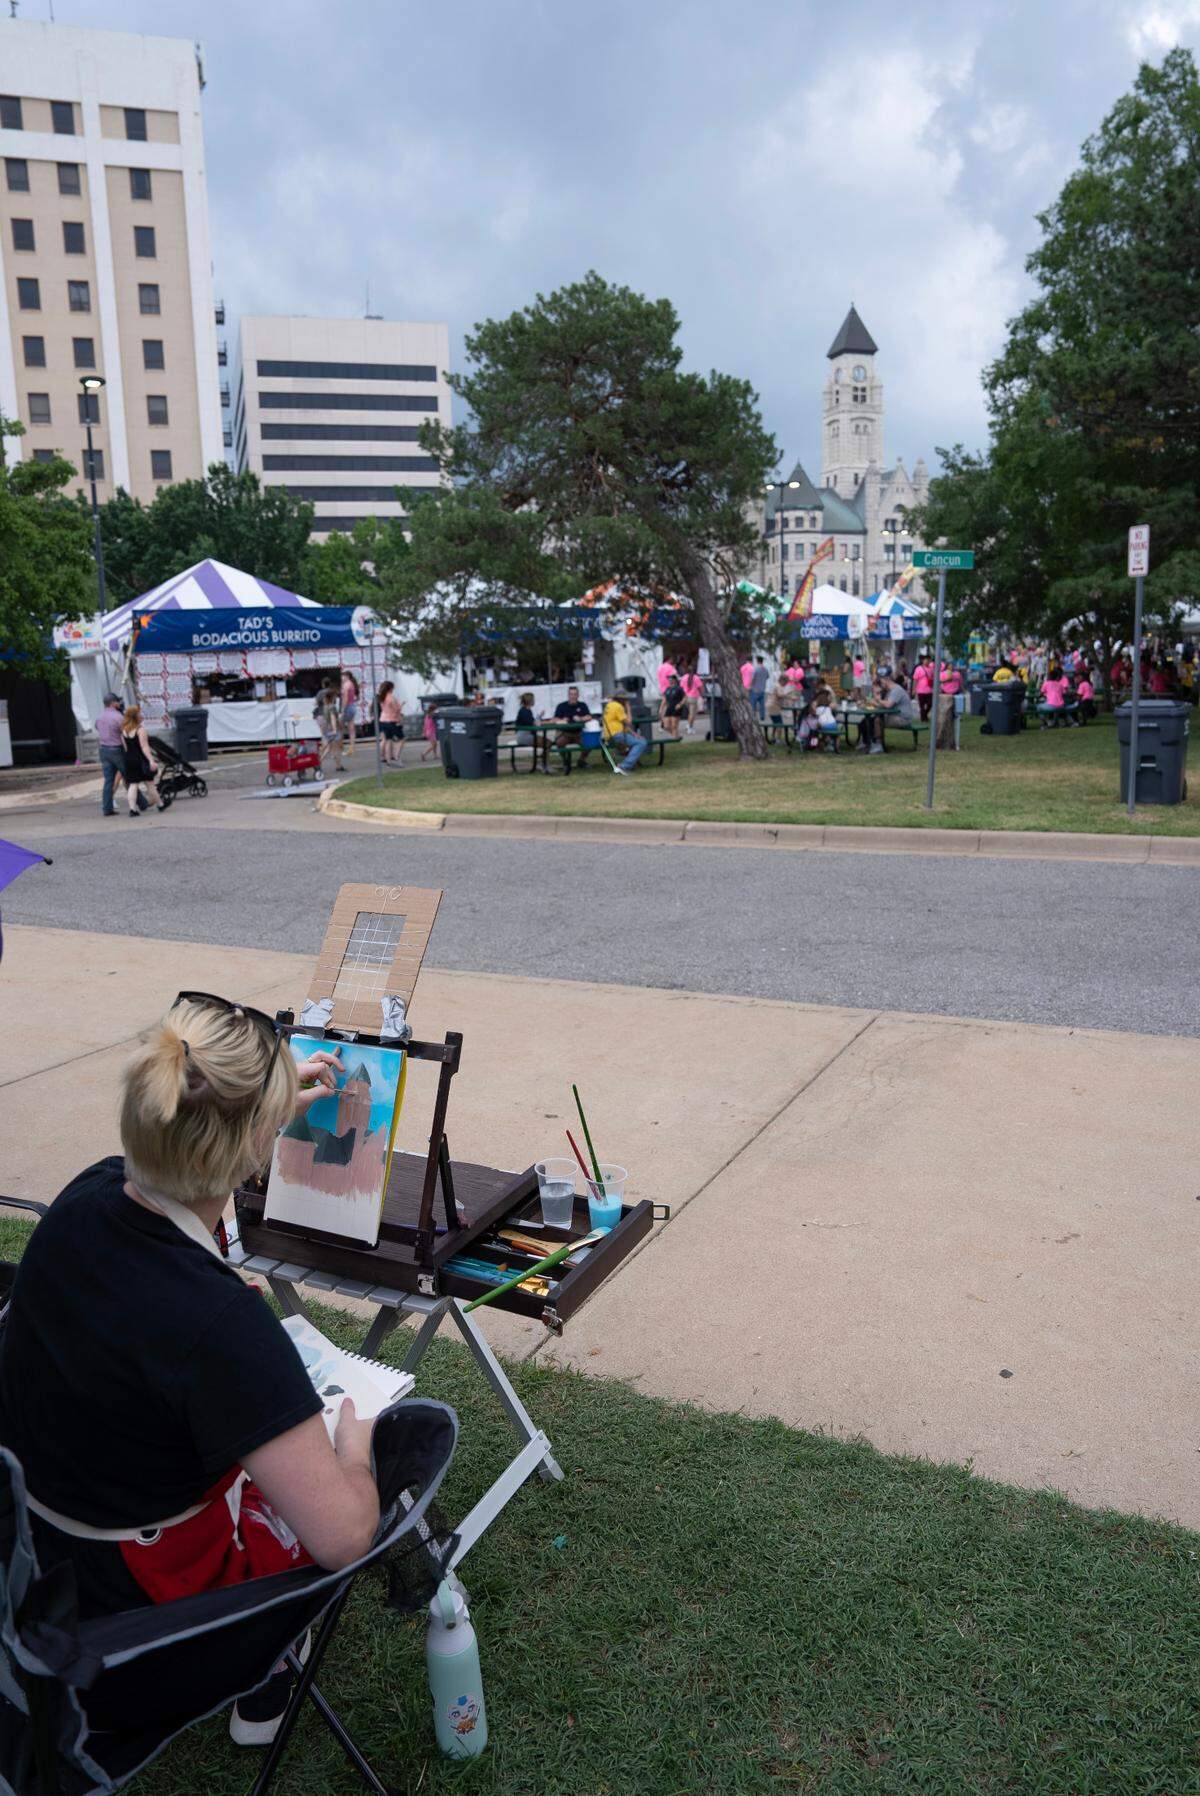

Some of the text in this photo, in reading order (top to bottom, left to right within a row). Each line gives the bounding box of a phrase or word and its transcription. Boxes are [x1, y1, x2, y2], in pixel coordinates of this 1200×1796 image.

[924, 553, 961, 566] Cancun
[237, 616, 274, 630] TAD'S
[192, 629, 321, 647] BODACIOUS BURRITO
